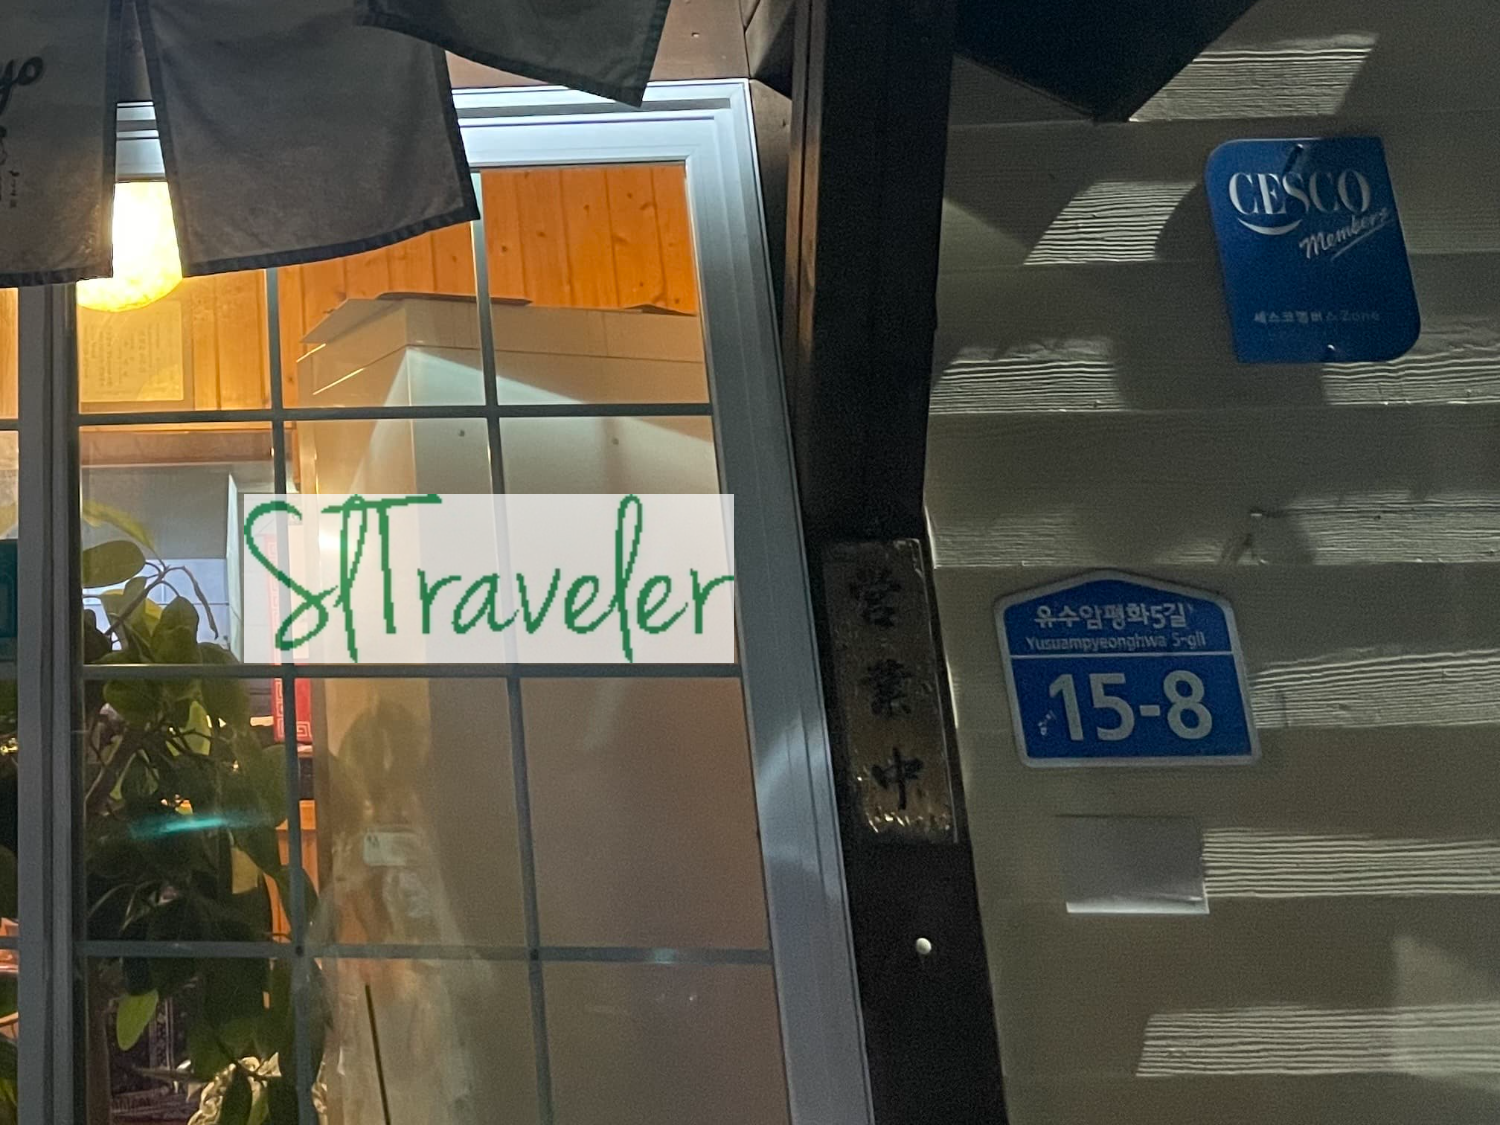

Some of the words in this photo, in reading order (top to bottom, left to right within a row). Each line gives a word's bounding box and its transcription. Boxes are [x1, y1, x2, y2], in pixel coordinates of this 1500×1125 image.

[1229, 170, 1371, 215] CESCO
[1034, 602, 1188, 631] 유수암평화5길
[1025, 633, 1167, 652] Yusuampyeonghwa
[1050, 670, 1213, 742] 15-8
